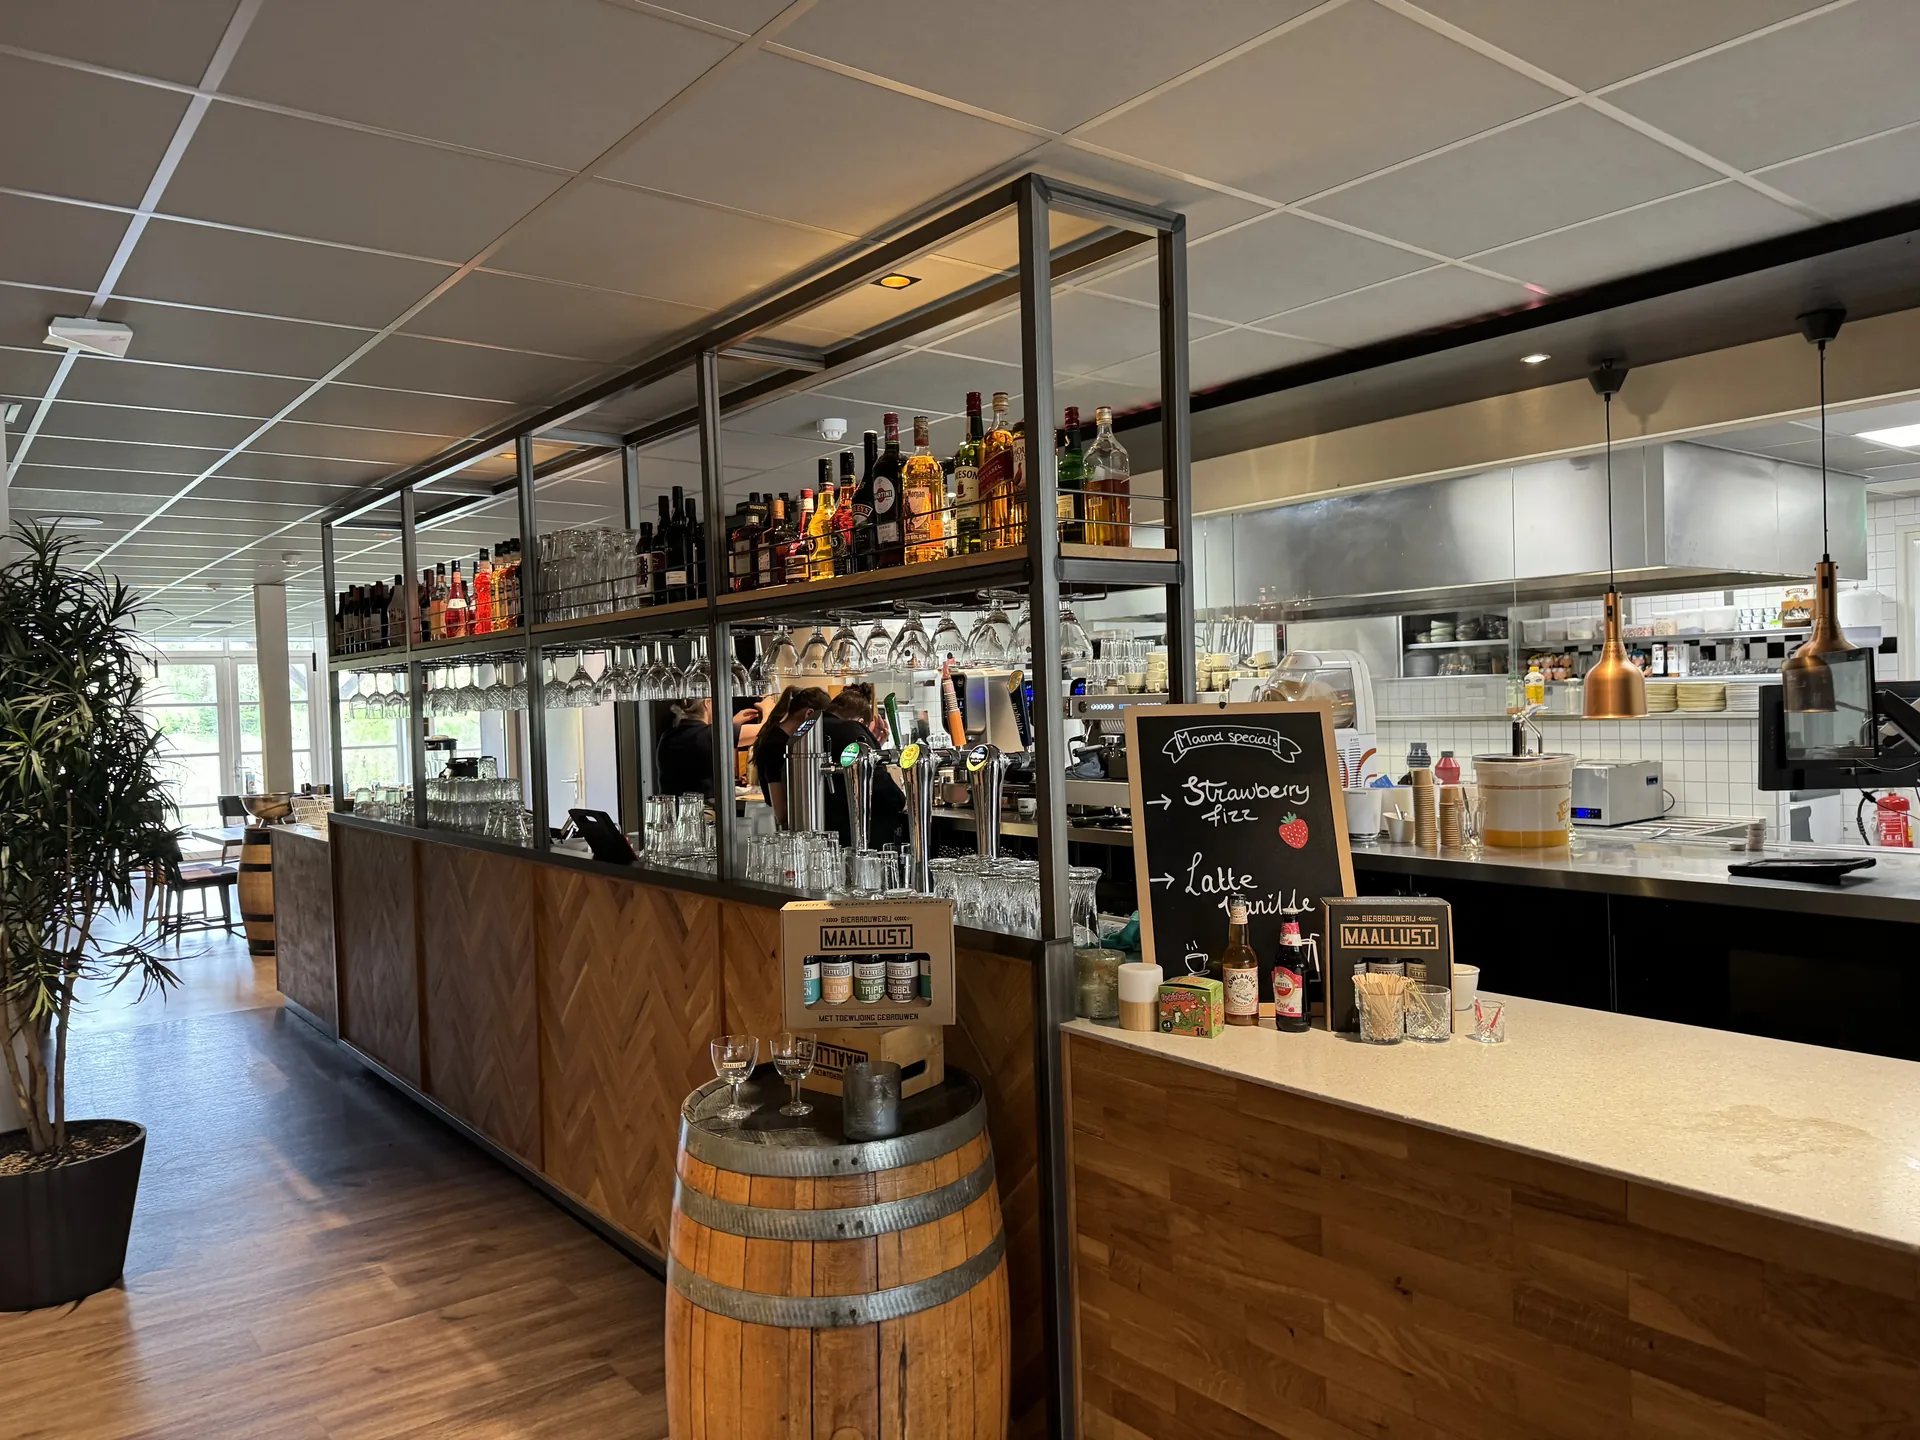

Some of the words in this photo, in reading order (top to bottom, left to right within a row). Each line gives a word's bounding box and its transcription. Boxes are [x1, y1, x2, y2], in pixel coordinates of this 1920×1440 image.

[1177, 731, 1224, 748] Maand
[1228, 732, 1278, 748] specials
[1181, 775, 1310, 806] Strawberry
[1185, 852, 1258, 897] Latte
[840, 915, 892, 924] BIERBROUWERIJ
[1361, 915, 1417, 923] BIERBROUWERIJ
[861, 984, 886, 995] TRIPEL
[818, 1014, 833, 1022] MET
[835, 1014, 876, 1022] TOEWIJDING
[877, 1012, 919, 1021] GEBROUWEN
